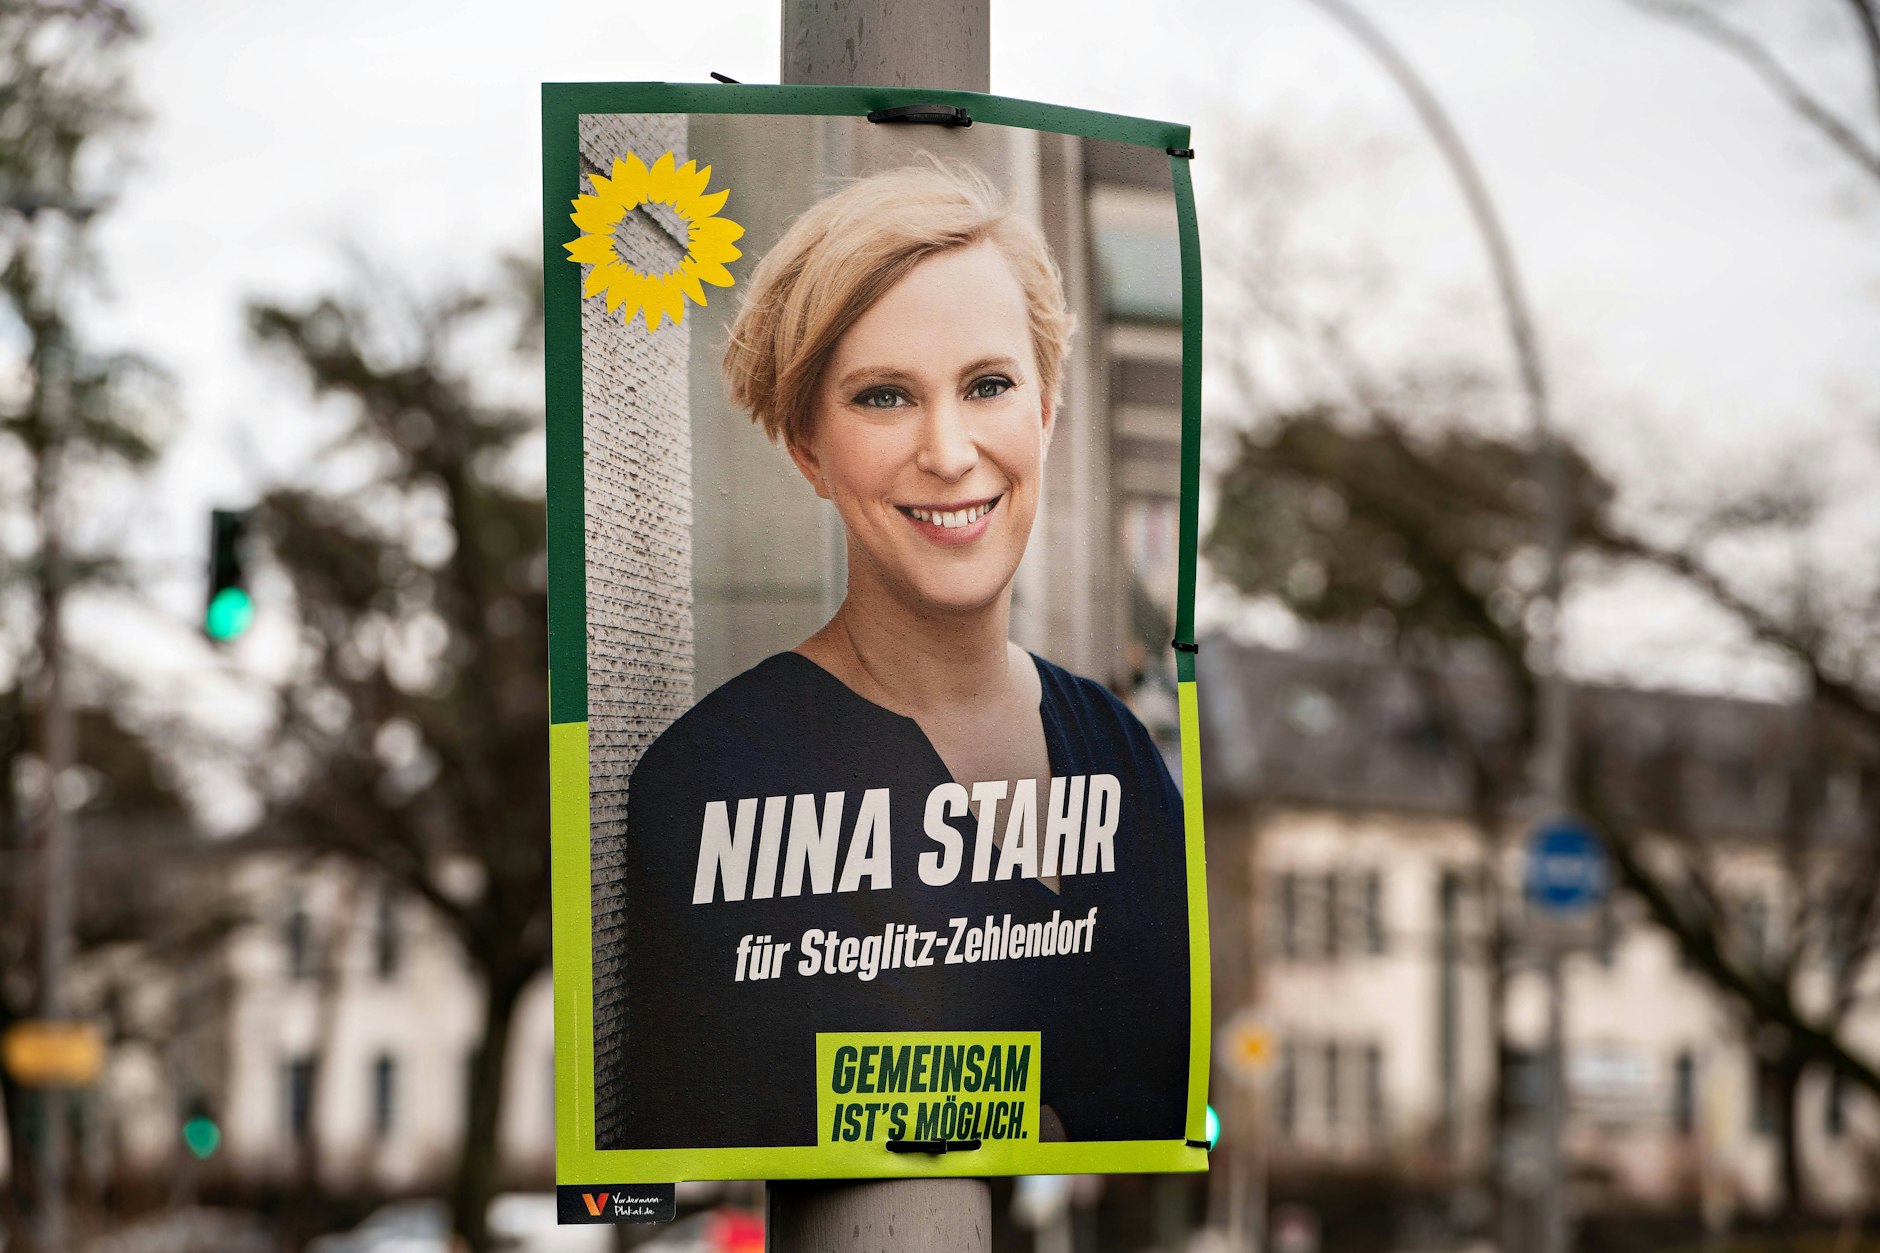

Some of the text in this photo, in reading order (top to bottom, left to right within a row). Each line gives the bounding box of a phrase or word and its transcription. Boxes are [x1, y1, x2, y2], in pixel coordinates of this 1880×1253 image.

[692, 774, 1122, 905] NINA STAHR
[735, 907, 1098, 982] für Steglitz-Zehlendorf
[831, 1044, 1032, 1095] GEMEINSAM
[831, 1095, 1028, 1142] IST’S MÖGLICH.
